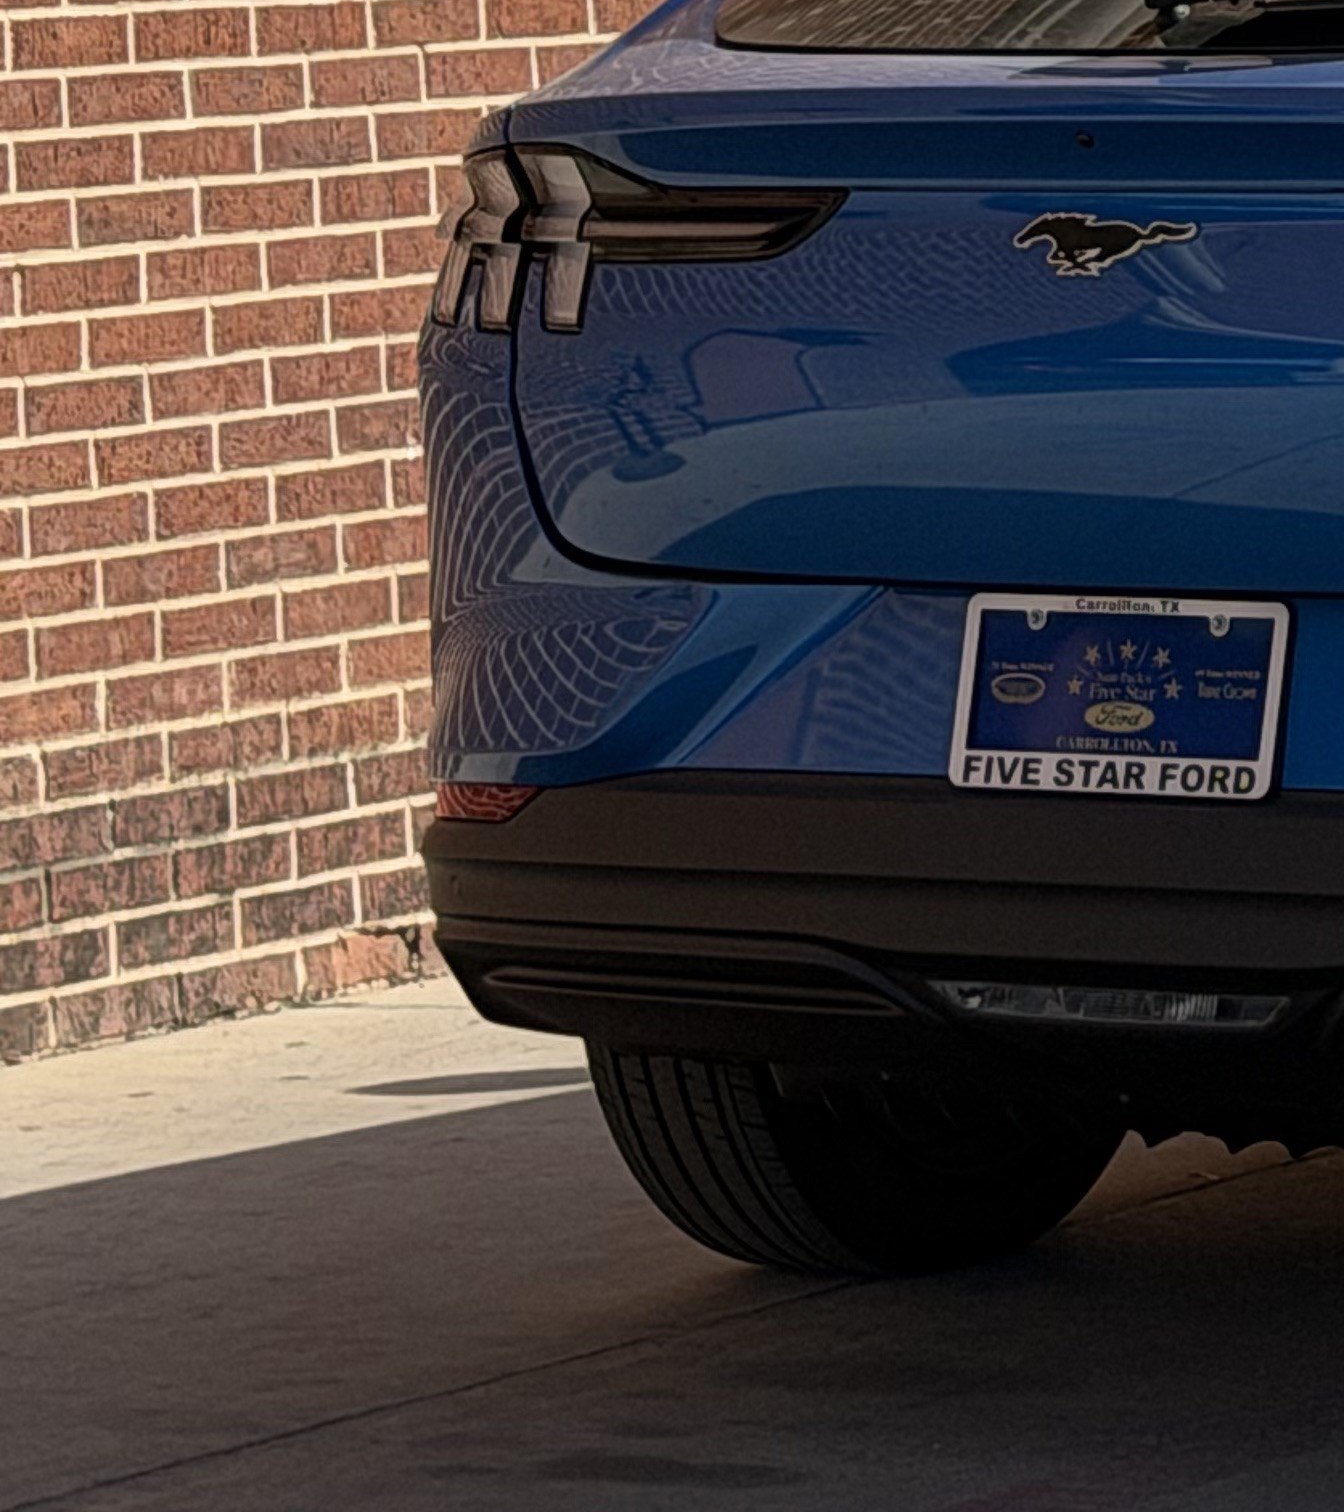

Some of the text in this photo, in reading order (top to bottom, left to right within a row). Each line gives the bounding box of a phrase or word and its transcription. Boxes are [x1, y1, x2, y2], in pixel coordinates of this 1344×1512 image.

[1161, 600, 1180, 613] TX
[1095, 703, 1144, 727] Ford
[962, 754, 1257, 795] FIVE STAR FORD
